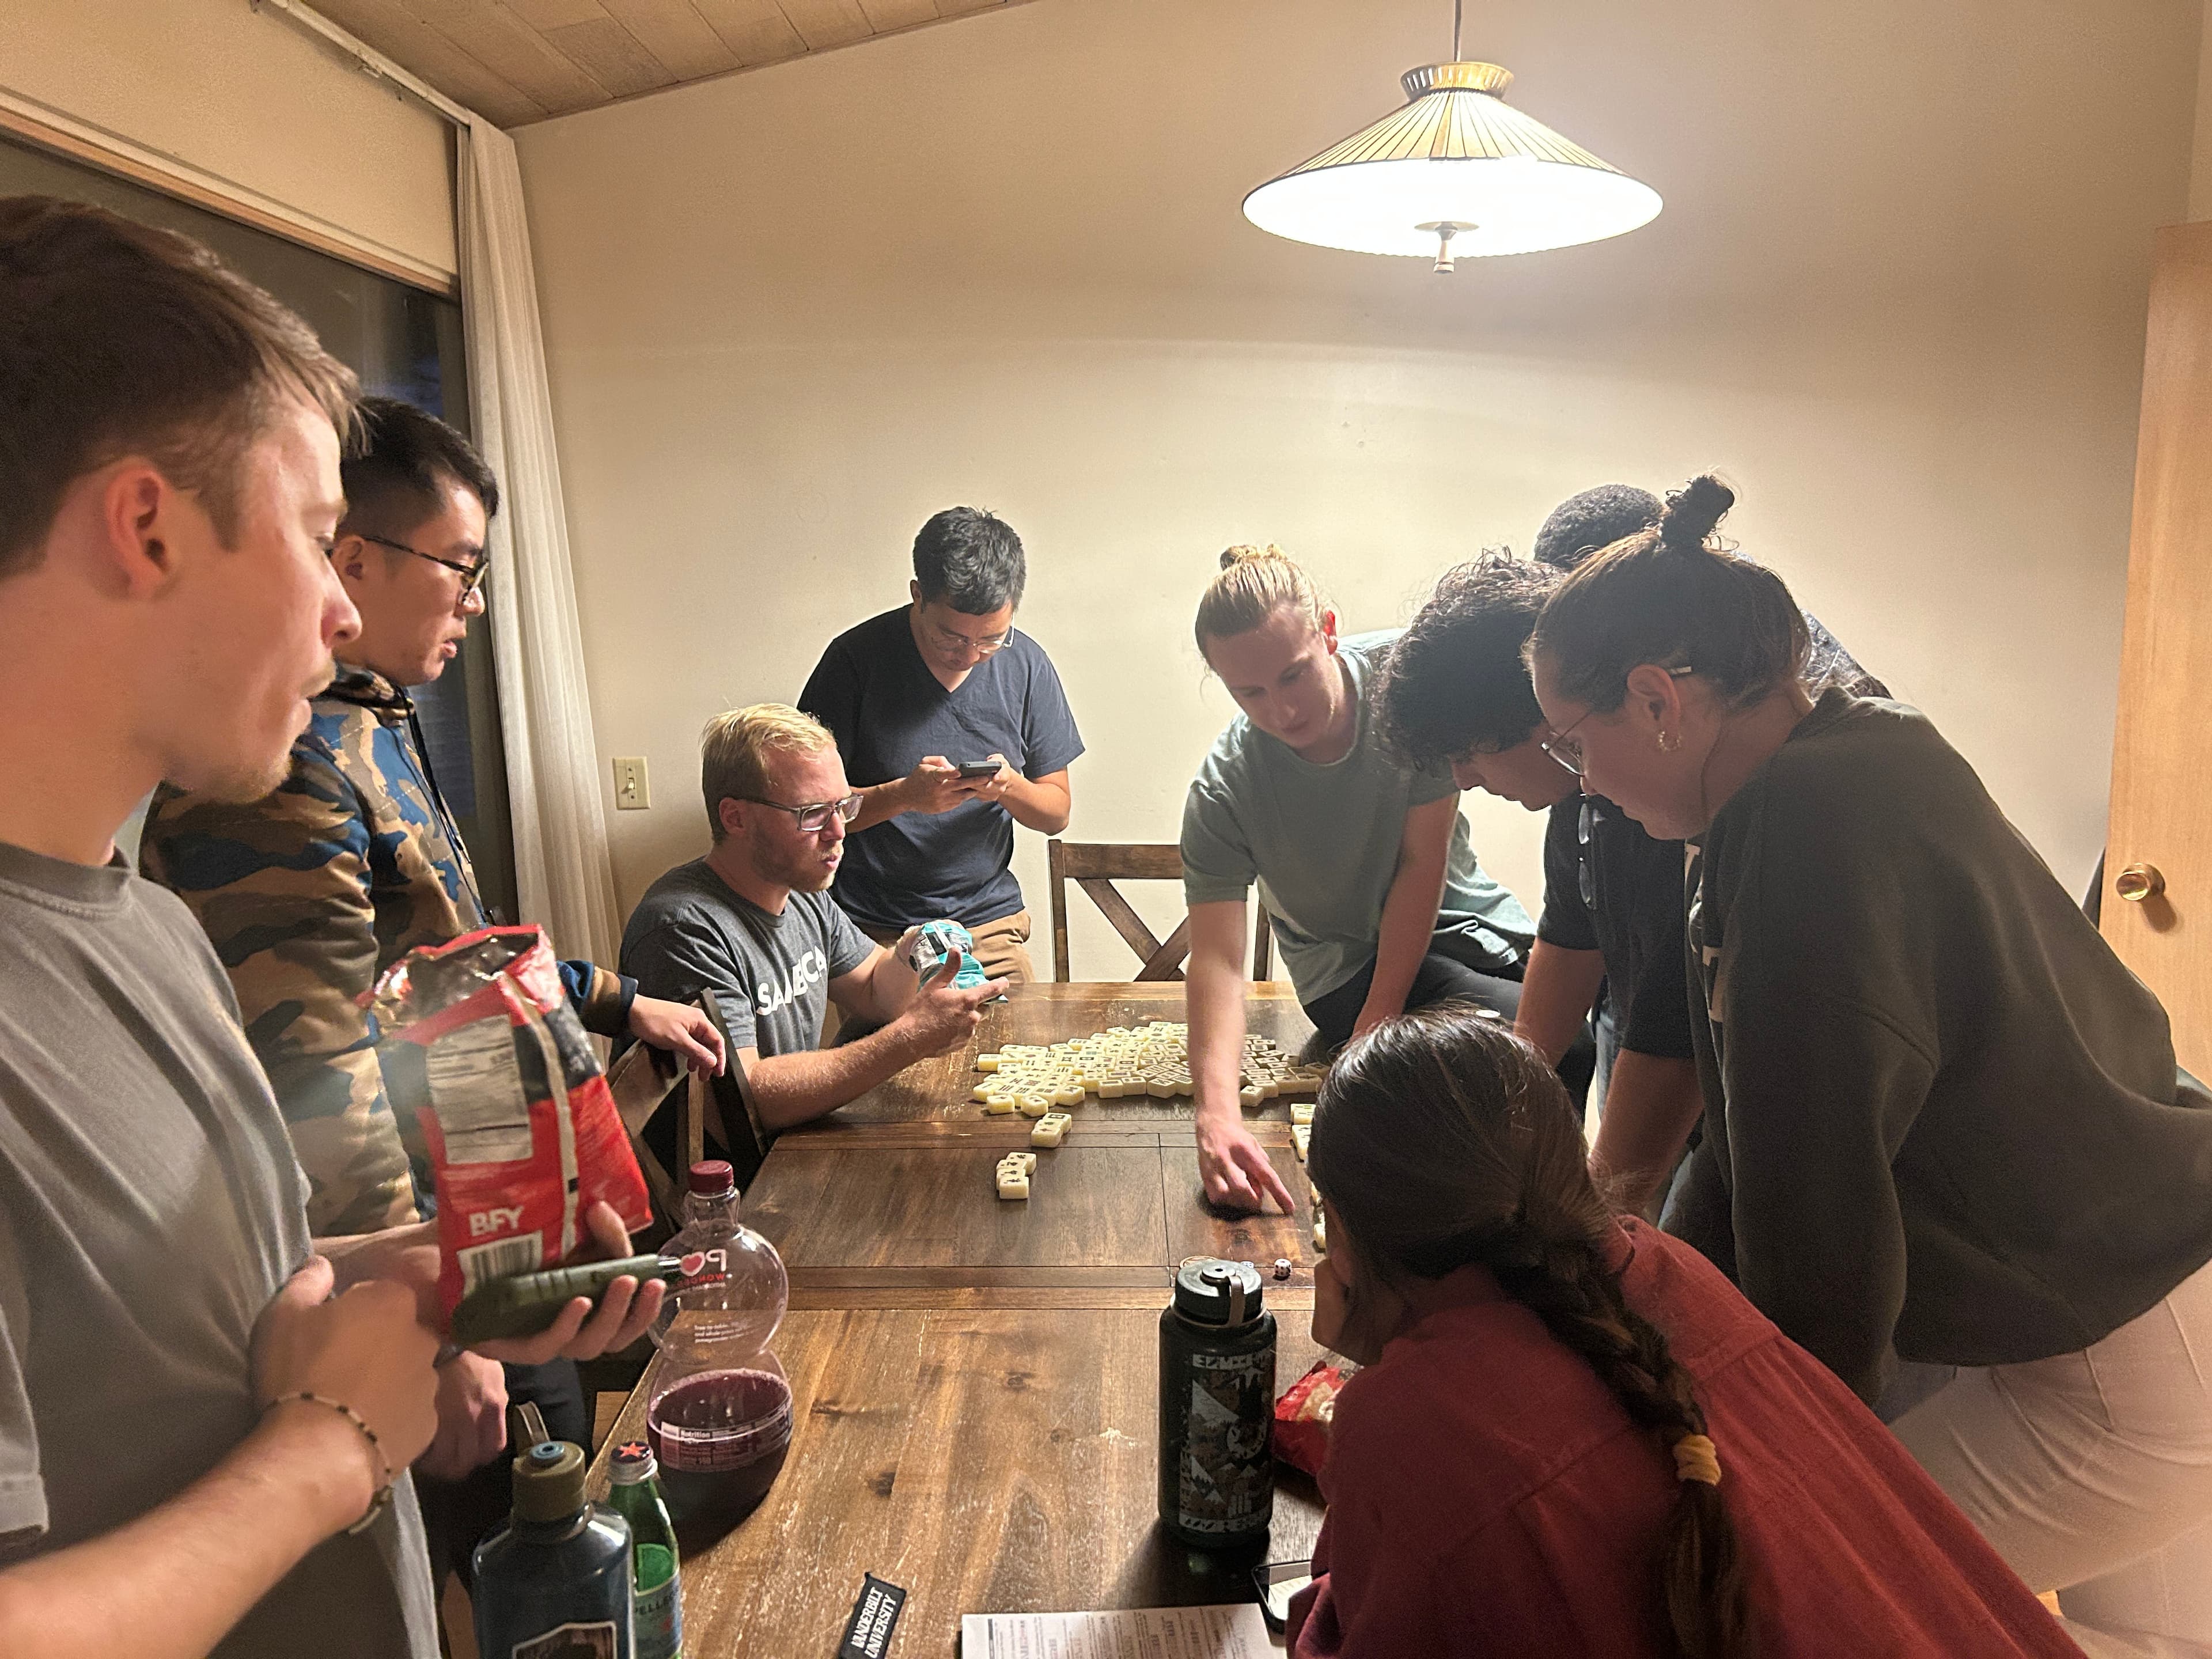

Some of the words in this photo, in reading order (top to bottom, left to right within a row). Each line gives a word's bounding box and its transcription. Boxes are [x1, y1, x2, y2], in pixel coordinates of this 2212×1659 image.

[469, 1205, 525, 1237] BFY
[680, 1429, 711, 1439] Nutrition
[851, 1586, 883, 1649] VANDERBILT
[864, 1593, 896, 1658] UNIVERSITY
